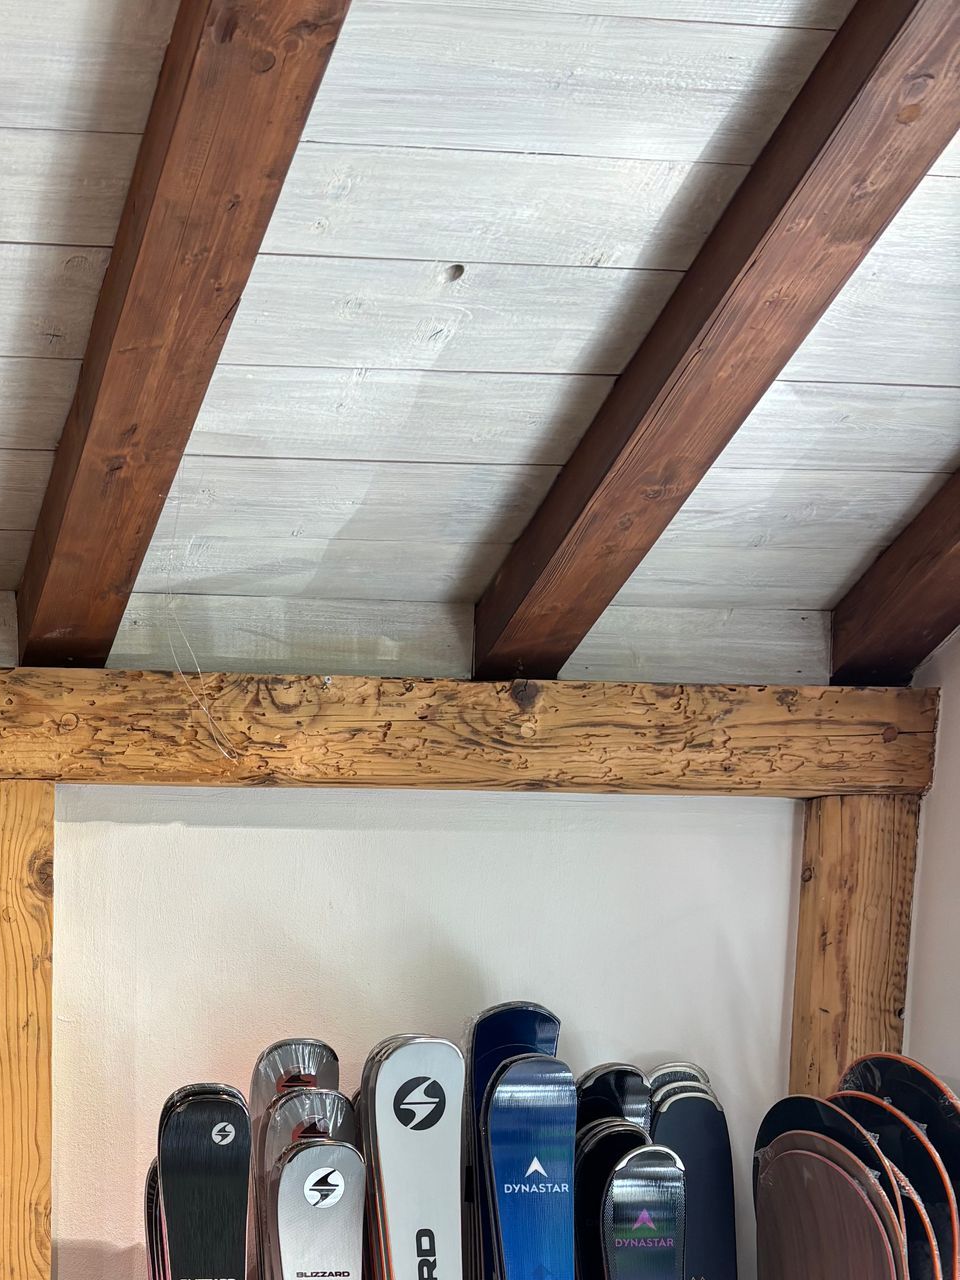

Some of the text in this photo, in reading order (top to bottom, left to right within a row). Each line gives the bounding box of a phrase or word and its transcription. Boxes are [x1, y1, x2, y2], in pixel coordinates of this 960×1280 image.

[504, 1183, 569, 1194] DYNASTAR
[615, 1238, 674, 1248] DYNASTAR
[296, 1270, 350, 1278] BLIZZARD
